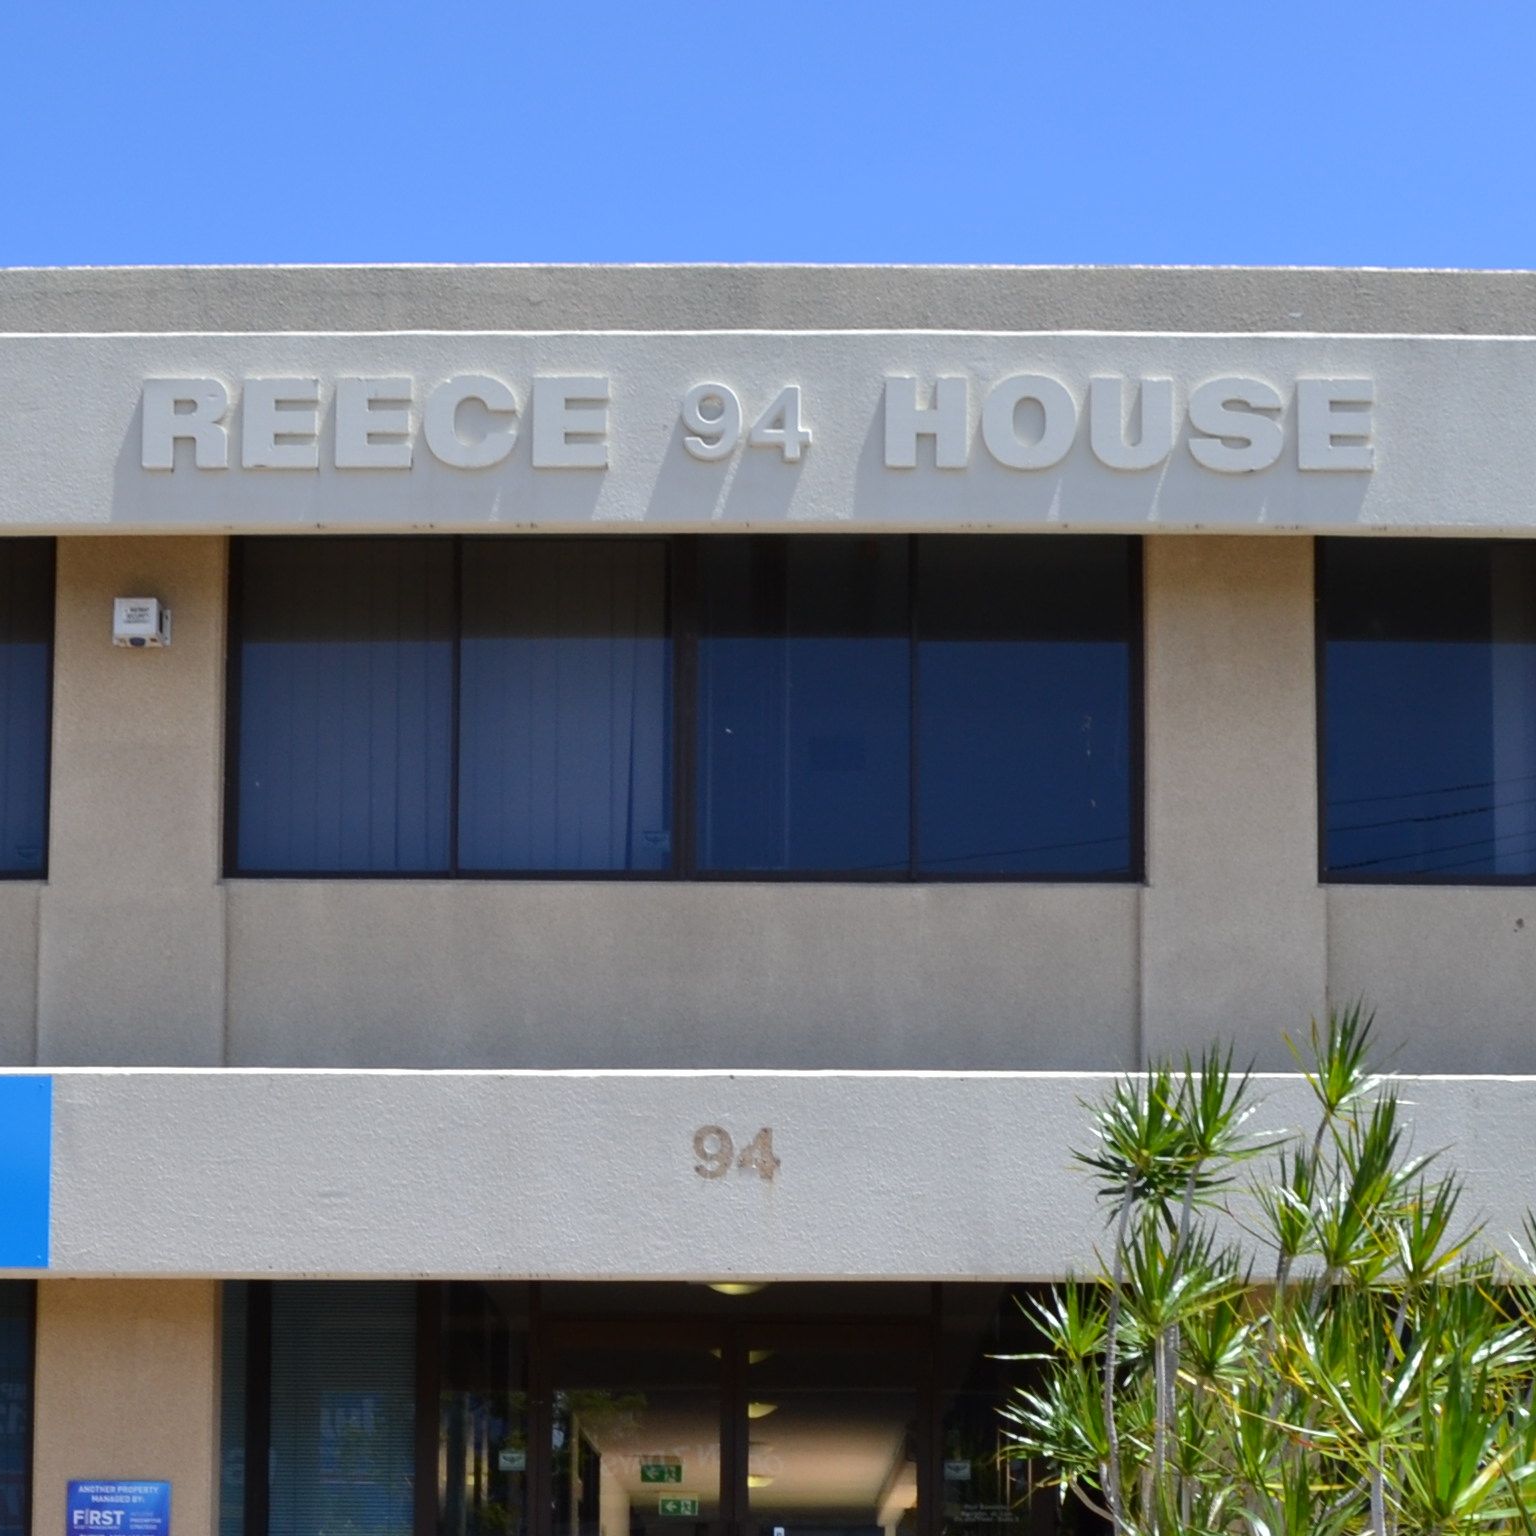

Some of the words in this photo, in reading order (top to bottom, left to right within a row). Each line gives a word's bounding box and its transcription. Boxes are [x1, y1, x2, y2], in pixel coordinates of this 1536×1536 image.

[138, 374, 611, 471] REECE
[679, 381, 813, 464] 94
[882, 373, 1376, 473] HOUSE
[693, 1124, 781, 1180] 94
[78, 1485, 116, 1494] ANOTHER
[117, 1485, 160, 1494] PROPERTY
[91, 1495, 131, 1503] MANAGED
[73, 1508, 125, 1526] FIRST
